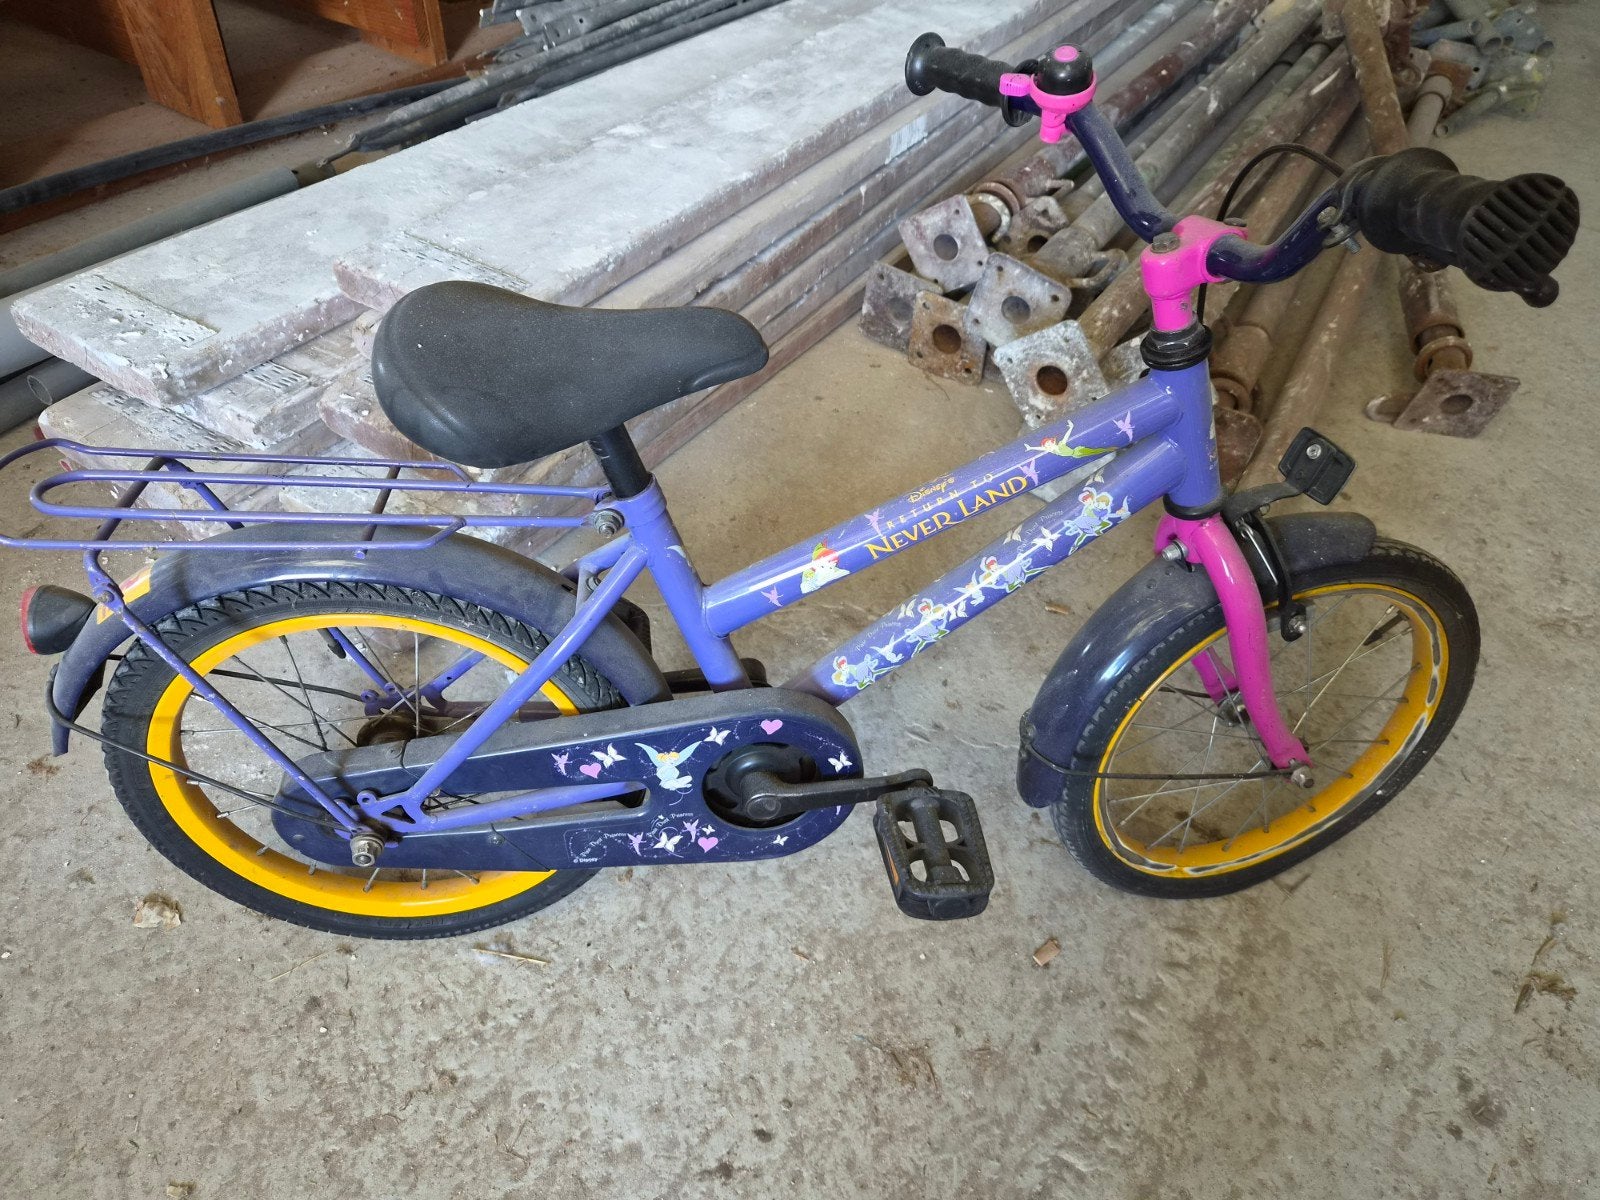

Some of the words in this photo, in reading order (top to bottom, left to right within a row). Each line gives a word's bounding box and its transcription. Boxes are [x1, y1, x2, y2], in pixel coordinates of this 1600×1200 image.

[865, 511, 960, 560] NEVER
[957, 475, 1028, 518] LAND
[886, 489, 960, 529] RETURN
[970, 473, 994, 489] TO
